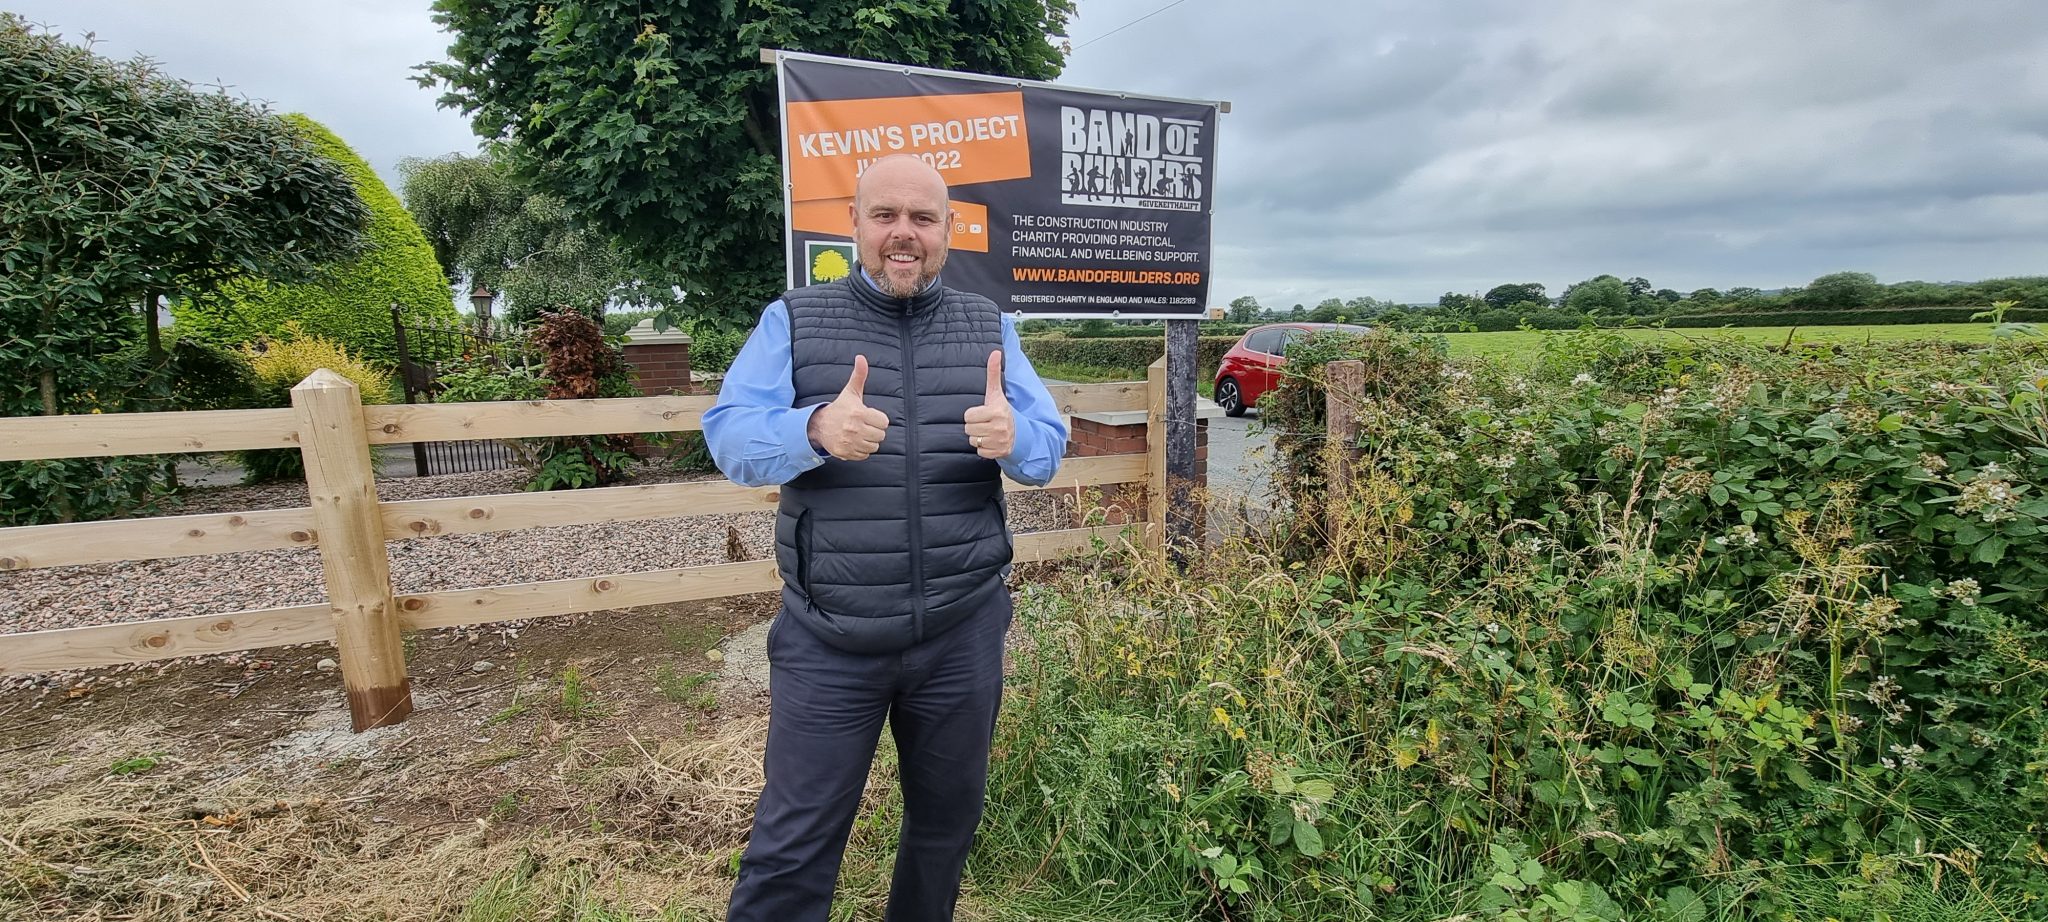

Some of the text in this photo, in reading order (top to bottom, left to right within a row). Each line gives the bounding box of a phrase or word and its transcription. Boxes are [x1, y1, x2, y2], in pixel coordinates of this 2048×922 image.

[799, 115, 1019, 158] KEVIN'S PROJECT
[1061, 106, 1199, 159] BAND OF
[912, 150, 962, 170] 022
[1061, 152, 1202, 200] BUILDERS
[1138, 200, 1199, 211] #GIVEKEITHALIFT
[1012, 214, 1169, 232] THE CONSTRUCTION INDUSTRY
[1012, 230, 1176, 249] CHARITY PROVIDING PRACTICAL,
[1012, 246, 1200, 263] FINANCIAL AND WELLBEING SUPPORT.
[1012, 268, 1200, 285] WWW.BANDOFBUILDERS.ORG
[1011, 295, 1055, 303] REGISTERED
[1056, 295, 1087, 303] CHARITY
[1096, 296, 1128, 304] ENGLAND
[1128, 296, 1143, 304] AND
